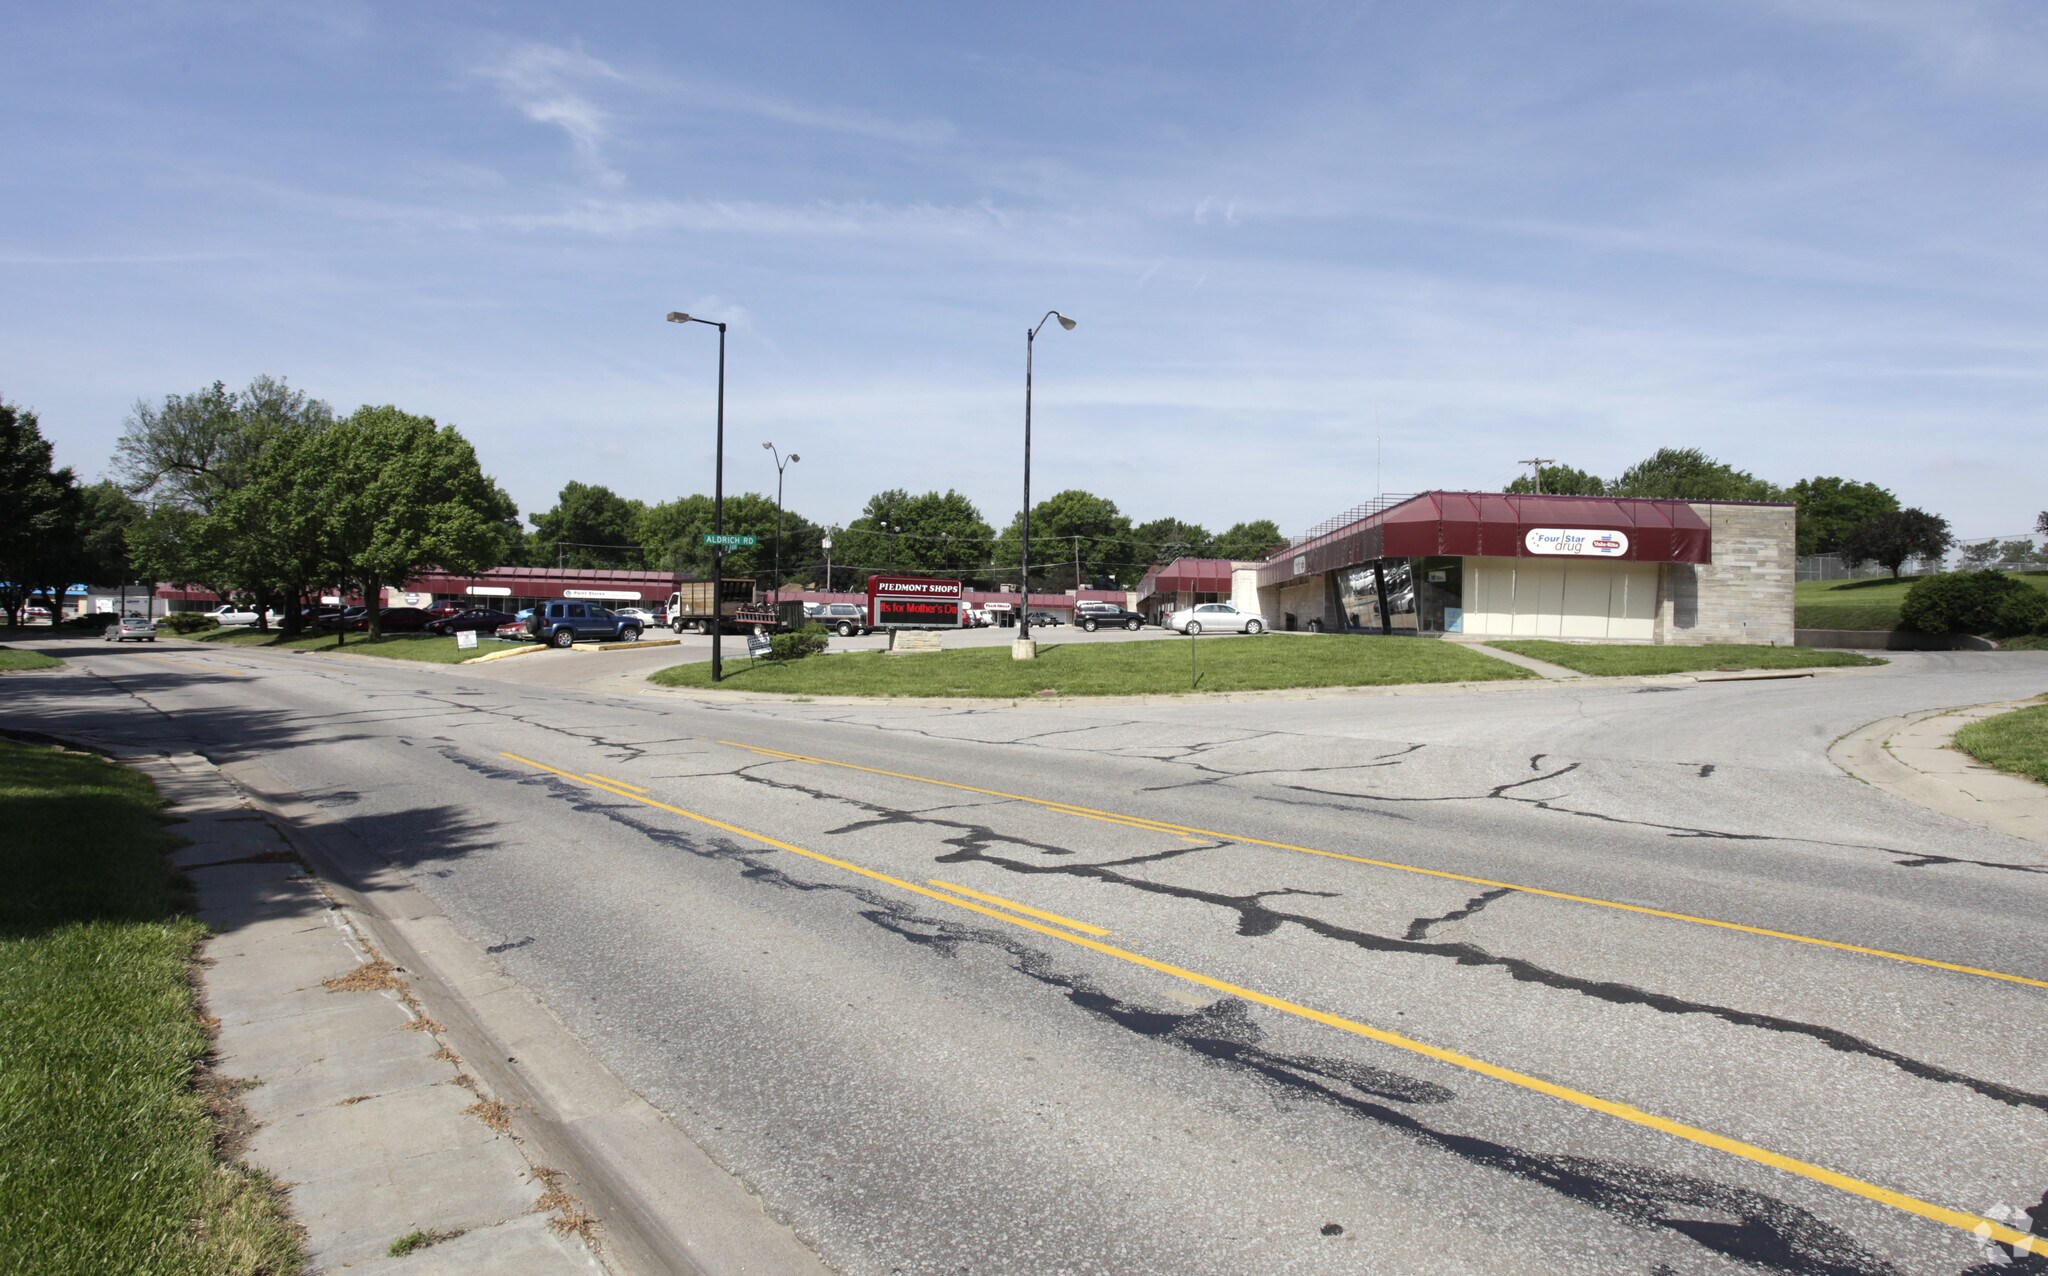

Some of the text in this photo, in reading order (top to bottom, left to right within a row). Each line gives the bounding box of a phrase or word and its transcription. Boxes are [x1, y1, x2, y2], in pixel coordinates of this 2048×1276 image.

[706, 535, 754, 545] ALDRICH RD
[1538, 534, 1586, 543] Four Star
[1555, 529, 1582, 554] drug
[879, 582, 958, 593] PIEDMONT SHOPS
[893, 603, 904, 613] for
[906, 603, 943, 614] Mother's
